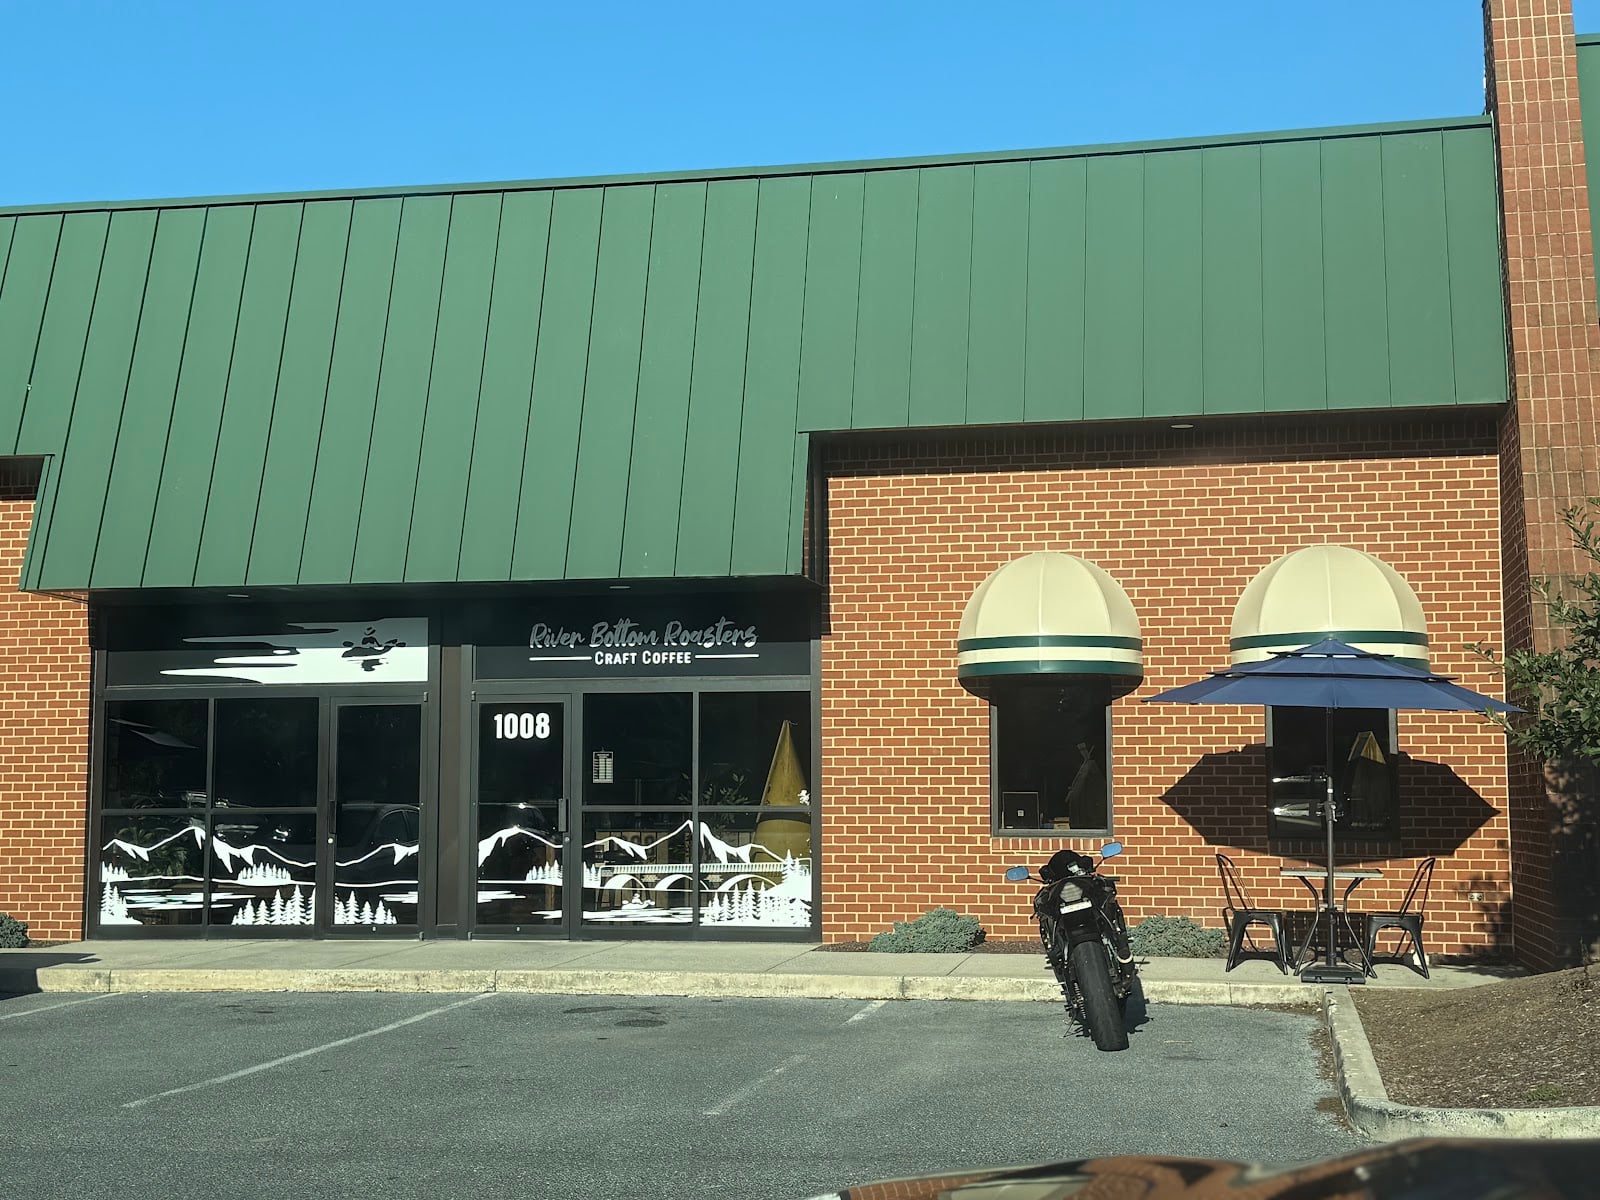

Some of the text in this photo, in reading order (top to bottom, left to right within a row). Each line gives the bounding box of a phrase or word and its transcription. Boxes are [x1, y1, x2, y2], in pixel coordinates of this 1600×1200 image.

[529, 616, 759, 649] River Bottom Roasters
[594, 650, 692, 665] CRAFT COFFEE
[493, 712, 550, 740] 1008
